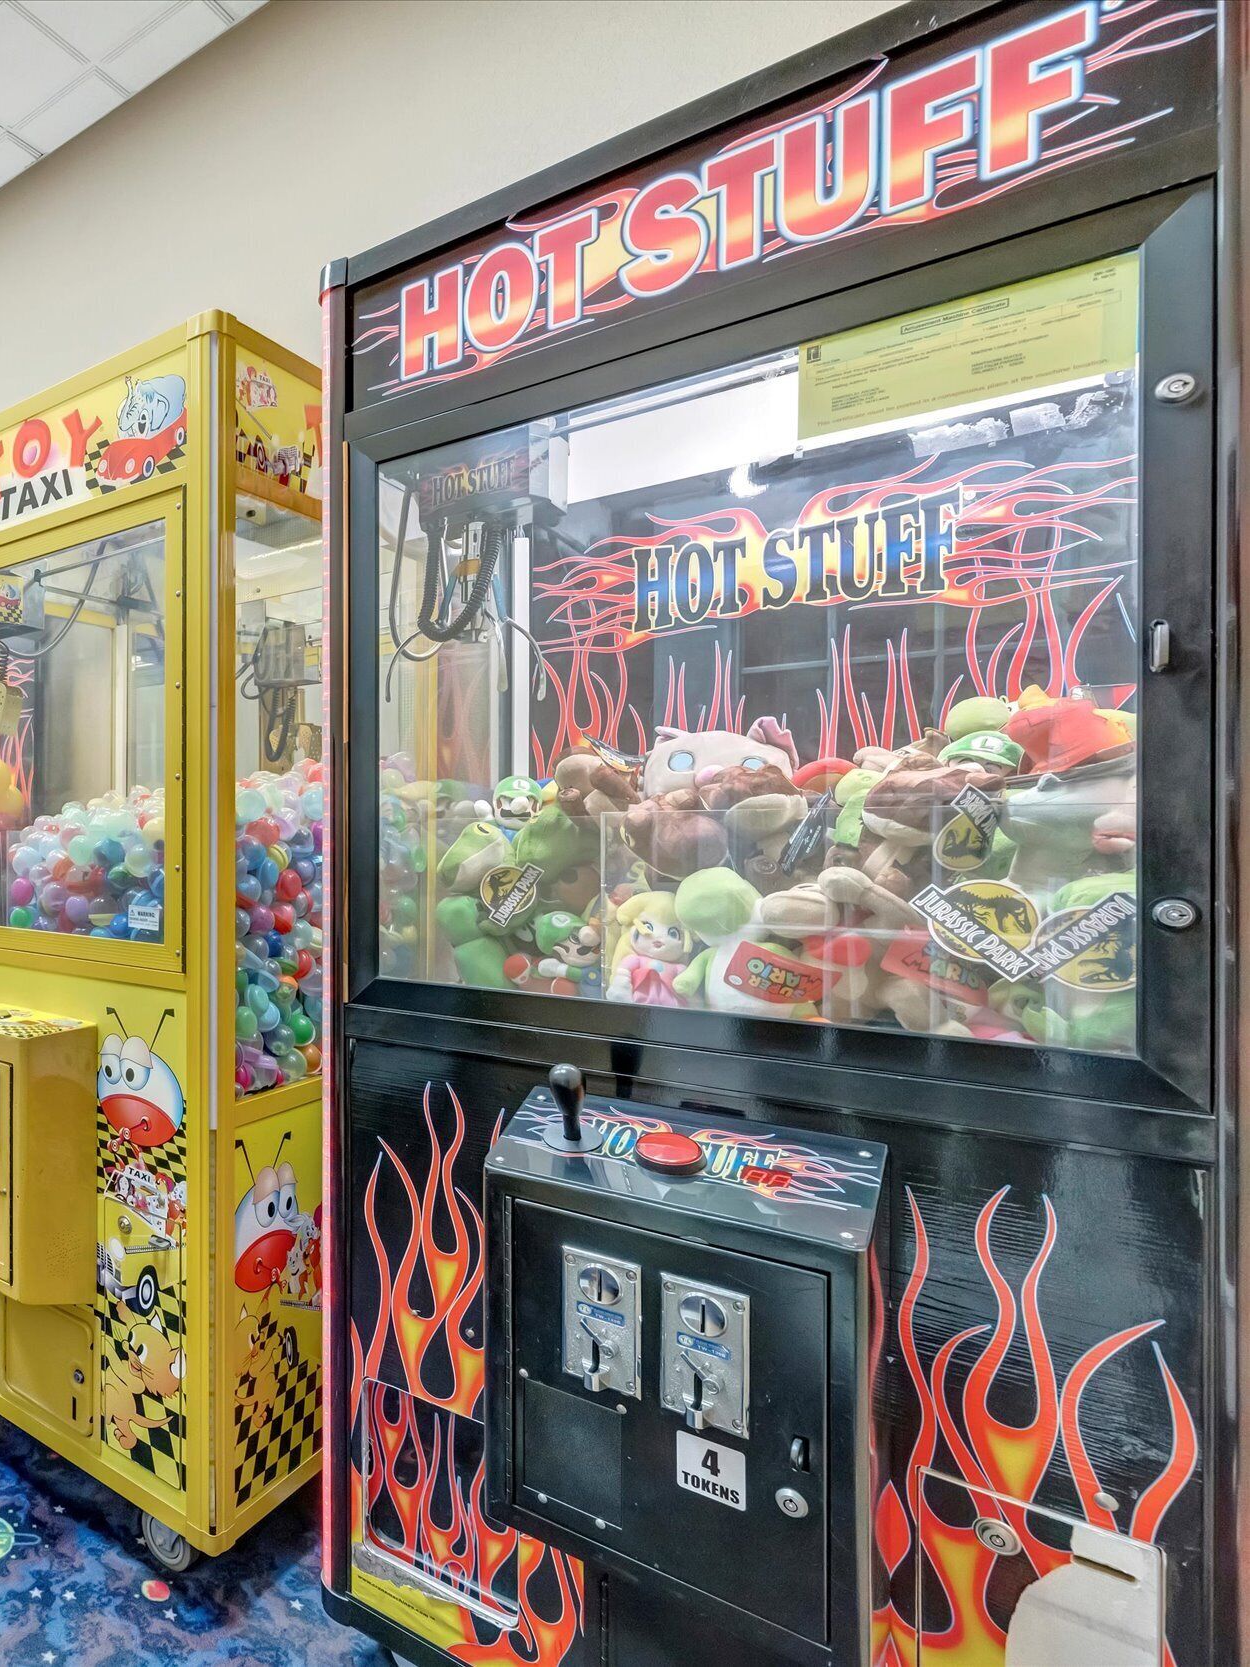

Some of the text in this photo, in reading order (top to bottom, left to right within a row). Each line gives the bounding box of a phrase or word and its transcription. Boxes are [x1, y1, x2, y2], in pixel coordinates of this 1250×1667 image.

[398, 2, 1098, 383] HOT STUFF
[1, 469, 73, 520] TAXI
[432, 455, 516, 507] HOT STUFF
[632, 483, 962, 633] HOT STUFF
[493, 867, 540, 924] JURASSIC PARK
[914, 890, 986, 943] JURASSIC
[972, 934, 1028, 975] PARK
[747, 958, 826, 994] MARIO
[748, 975, 806, 999] SUPER
[901, 951, 980, 990] MARIO
[592, 1117, 639, 1159] HO
[128, 1167, 150, 1182] TAXI
[701, 1449, 721, 1478] 4
[682, 1471, 740, 1505] TOKENS
